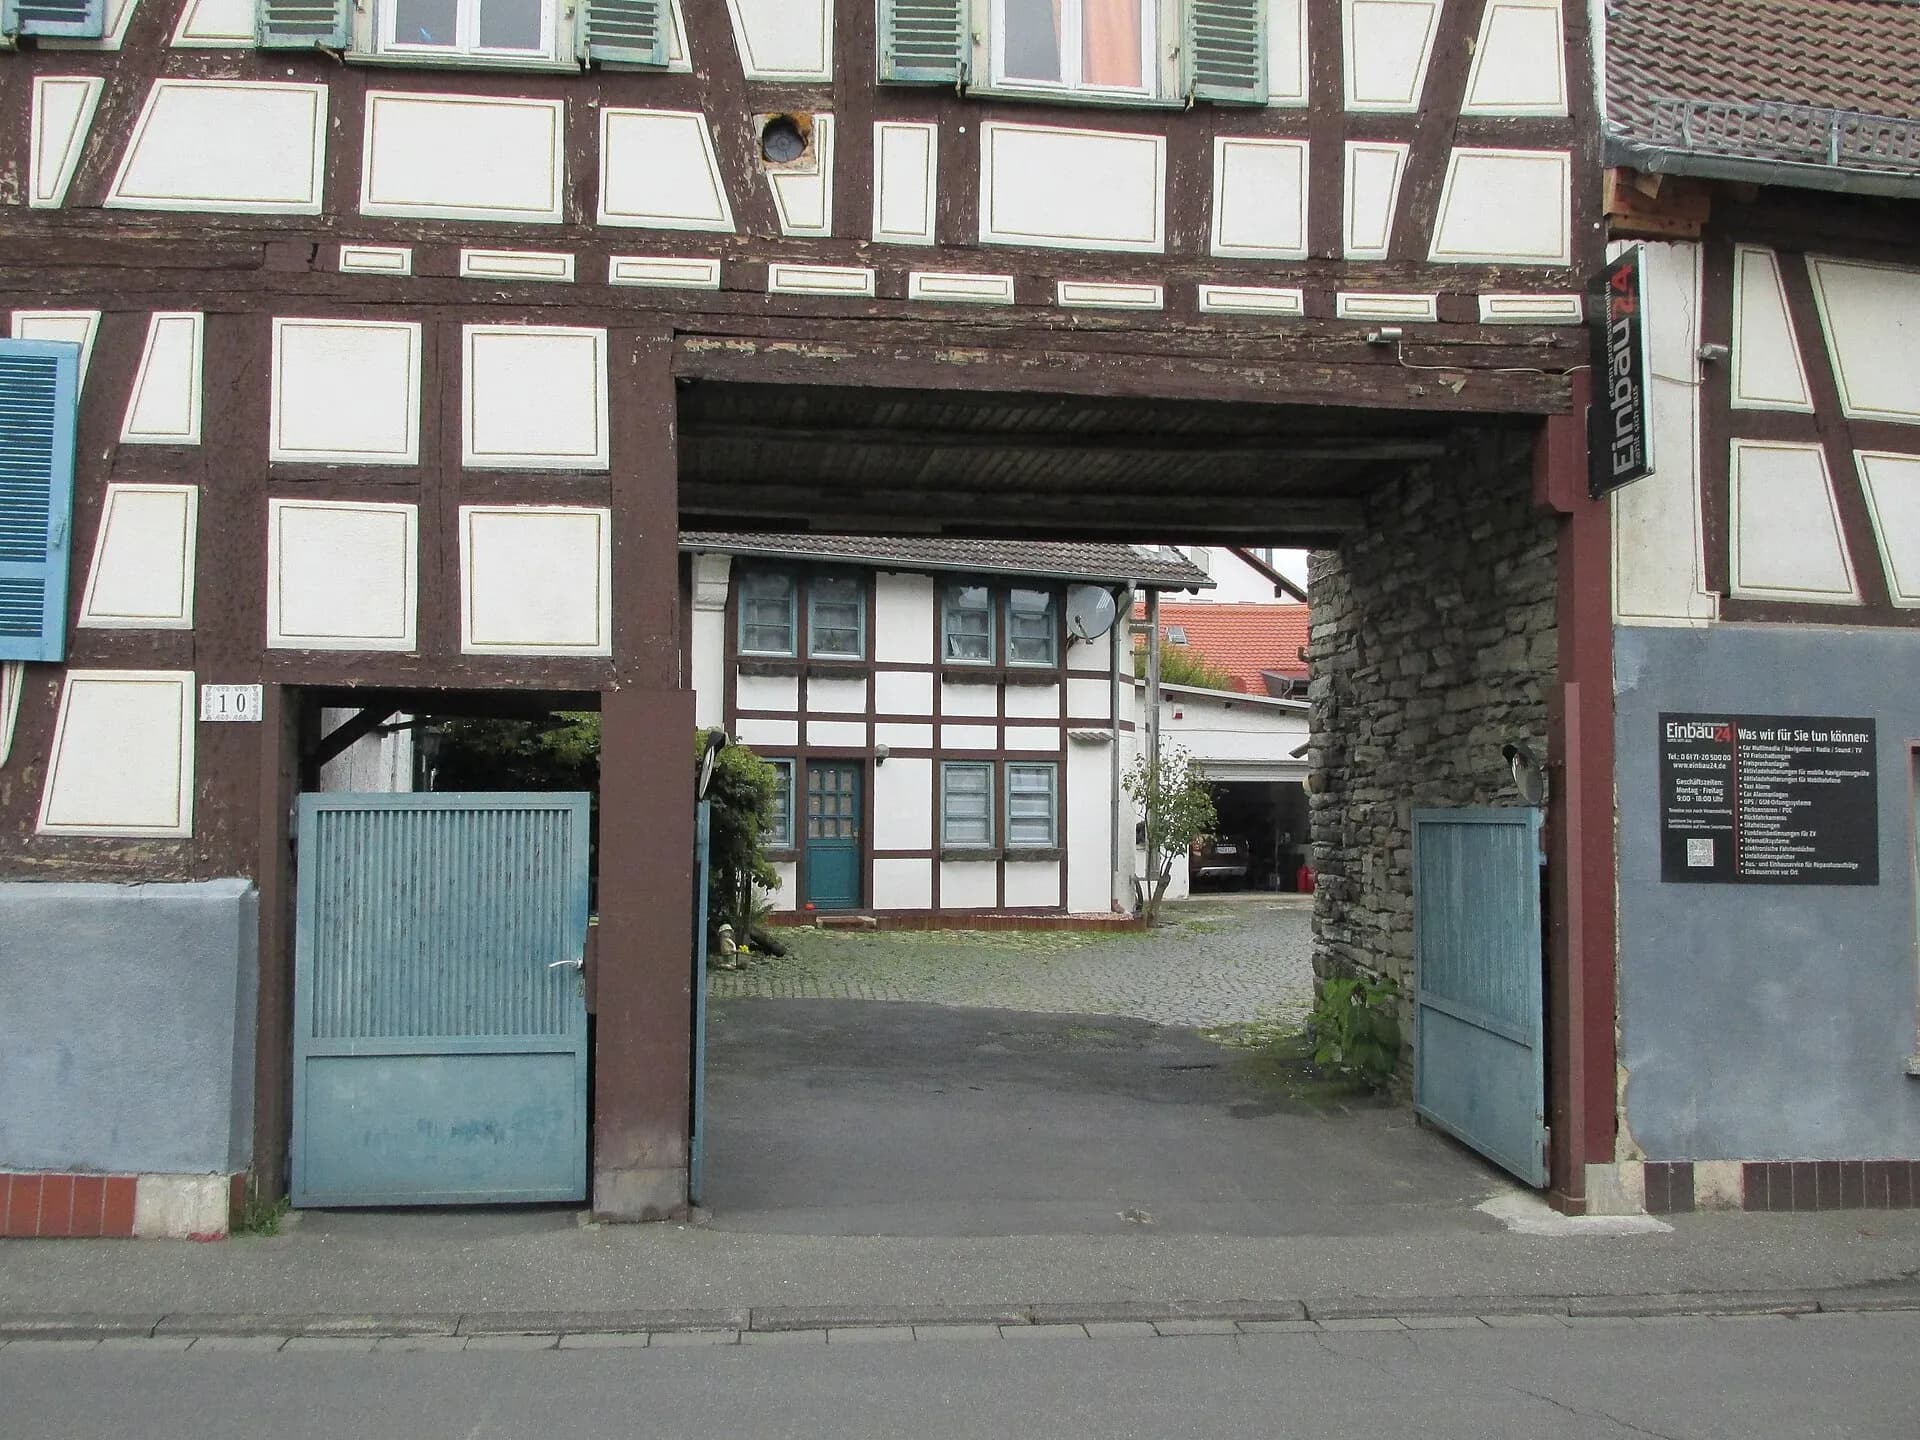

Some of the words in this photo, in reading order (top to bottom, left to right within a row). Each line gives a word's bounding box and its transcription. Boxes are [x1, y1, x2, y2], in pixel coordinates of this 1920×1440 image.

[219, 693, 246, 713] 10
[1738, 728, 1757, 740] Was
[1759, 729, 1774, 741] wir
[1777, 728, 1791, 741] für
[1794, 729, 1809, 741] Sie
[1811, 730, 1828, 741] tun
[1830, 730, 1869, 743] können:
[1676, 787, 1698, 795] Montag
[1702, 787, 1724, 796] Freitag
